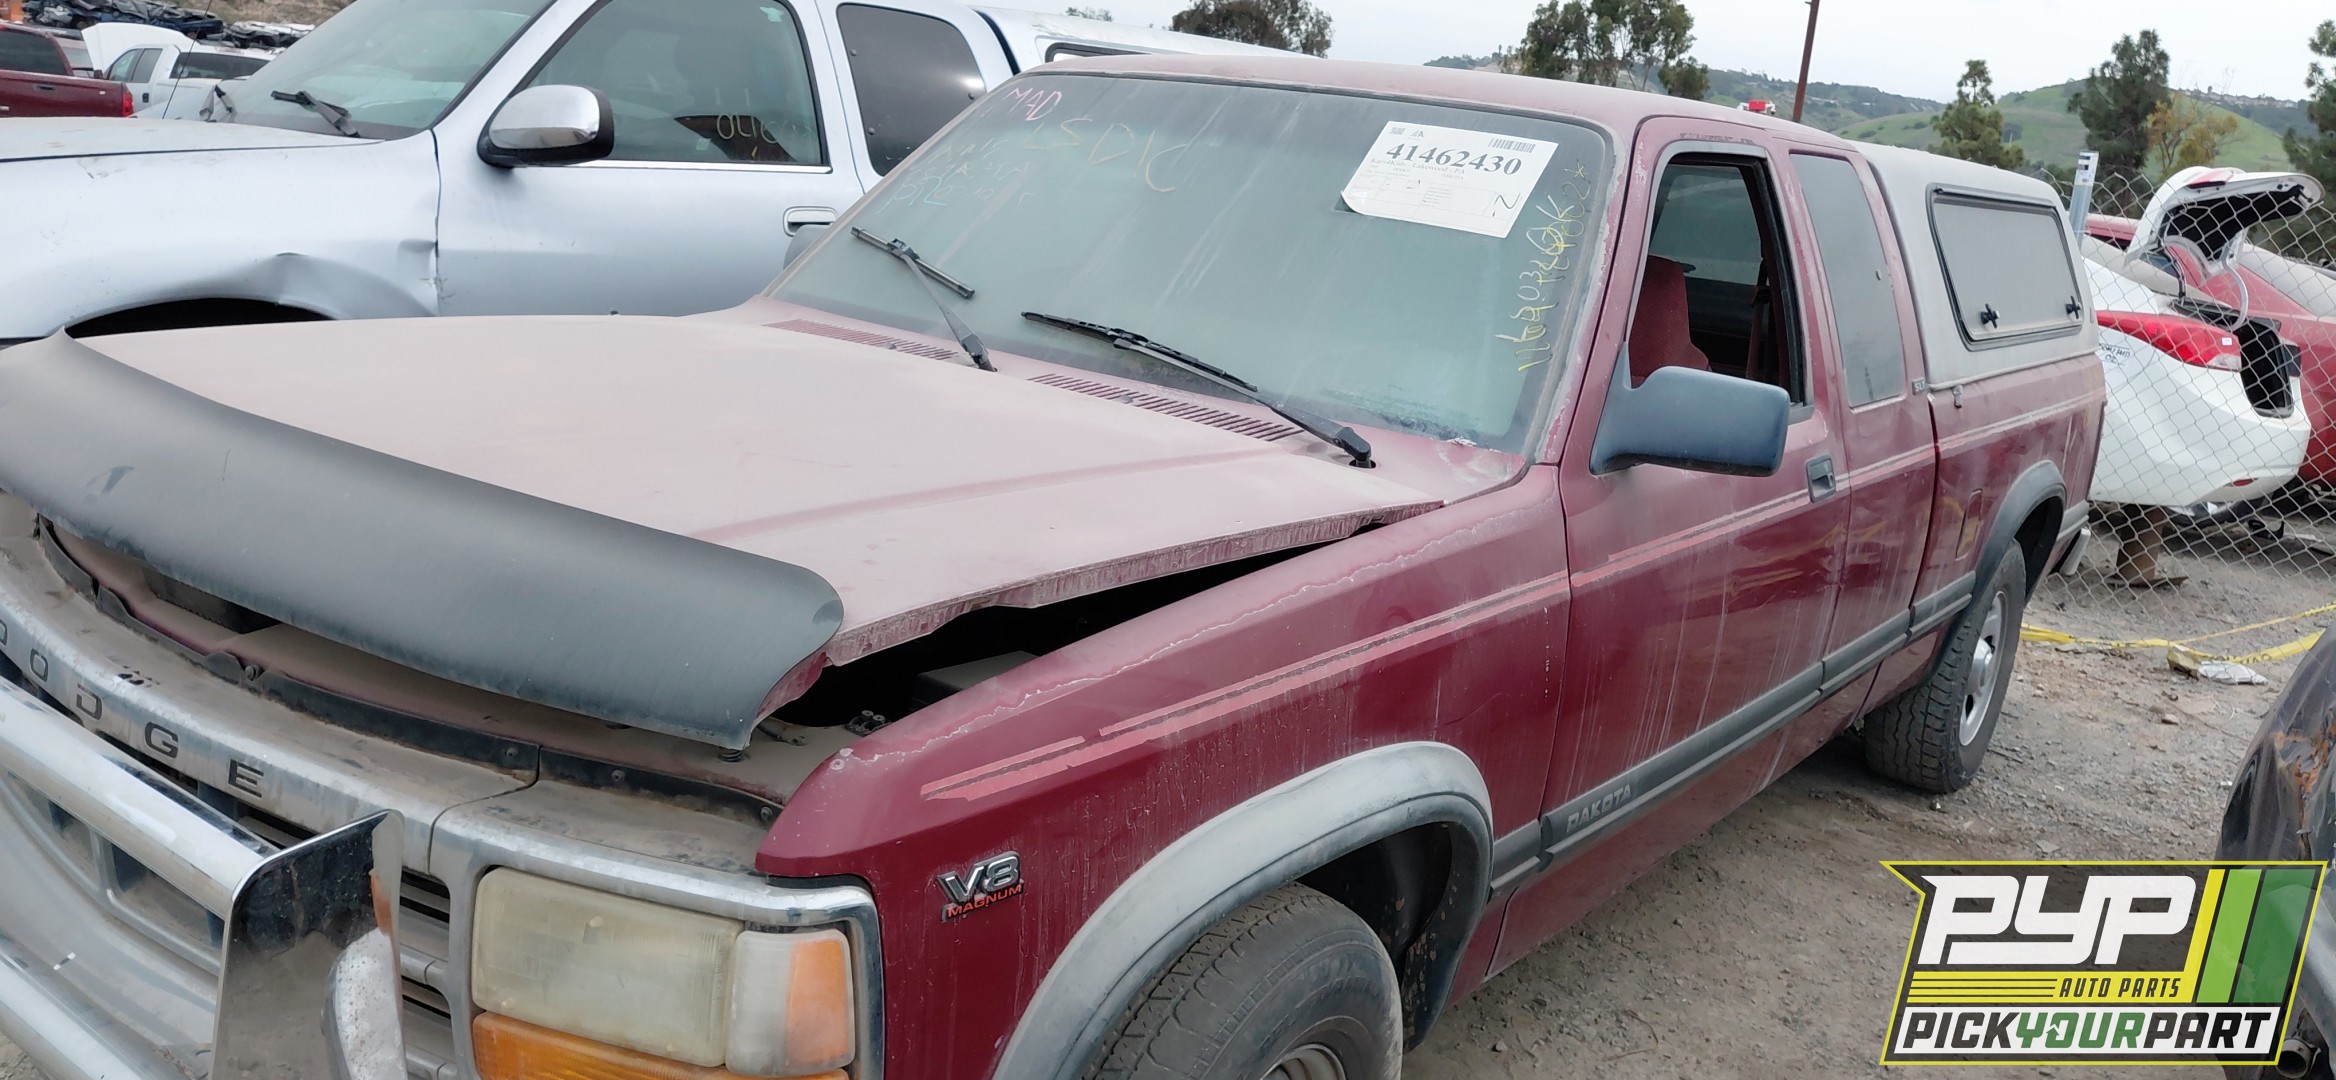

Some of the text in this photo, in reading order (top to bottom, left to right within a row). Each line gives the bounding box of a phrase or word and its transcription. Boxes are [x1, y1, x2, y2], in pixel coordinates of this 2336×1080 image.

[1386, 143, 1522, 175] 41462430
[1567, 784, 1631, 832] DAKOTA
[938, 851, 1021, 904] V8
[947, 884, 1022, 918] MAGNUM
